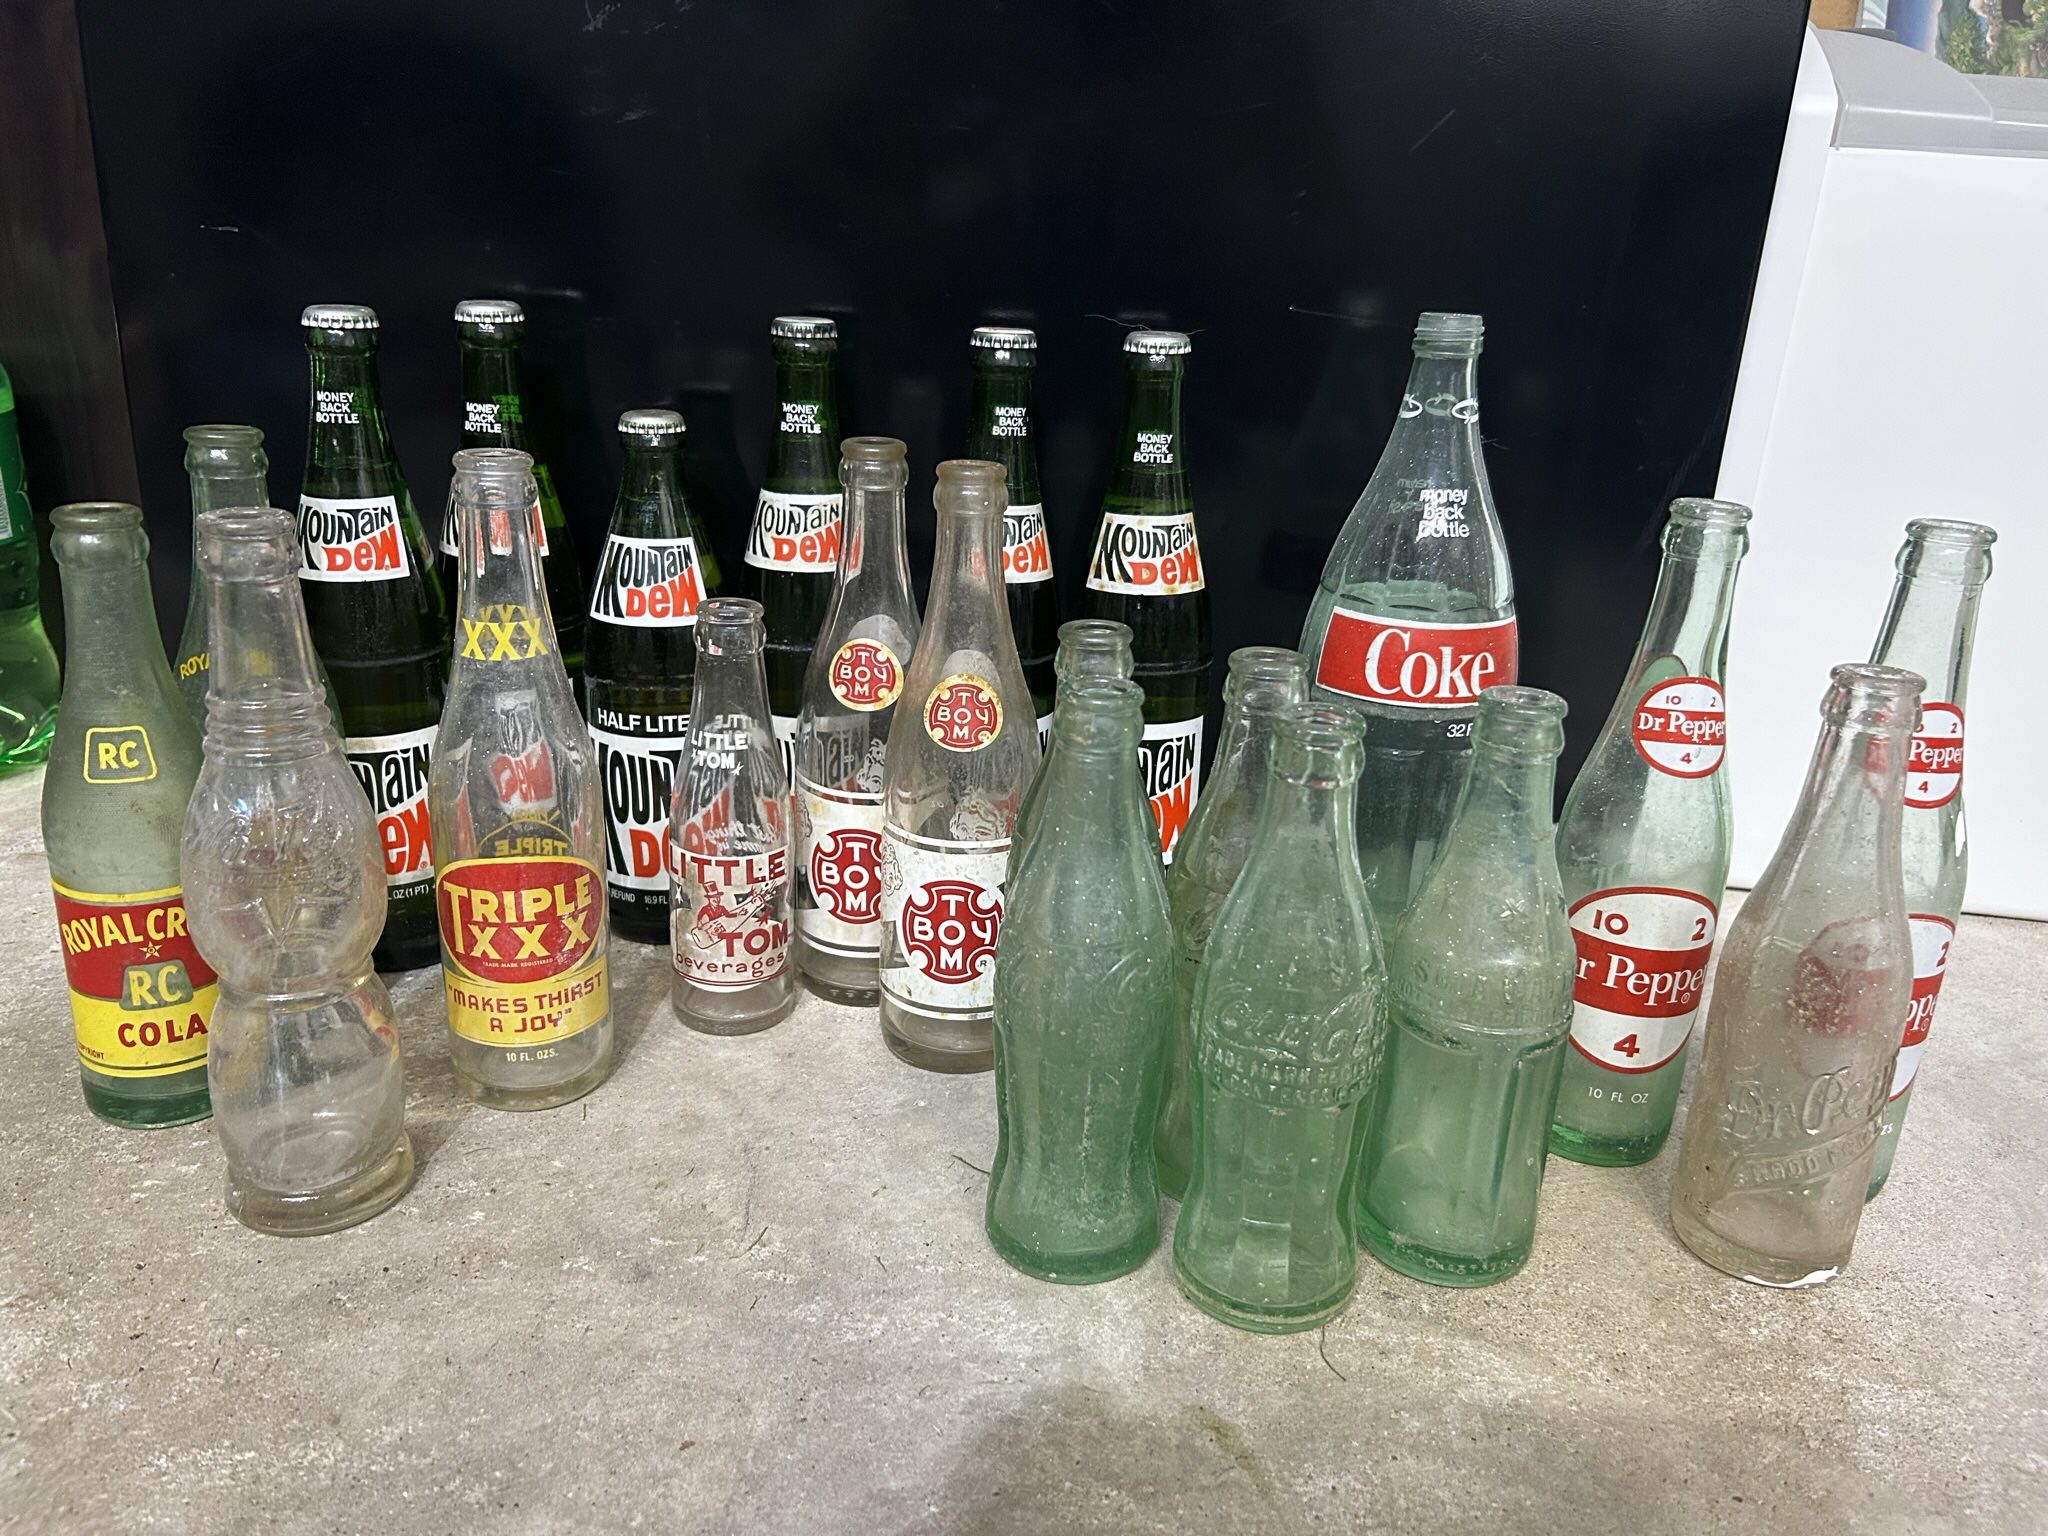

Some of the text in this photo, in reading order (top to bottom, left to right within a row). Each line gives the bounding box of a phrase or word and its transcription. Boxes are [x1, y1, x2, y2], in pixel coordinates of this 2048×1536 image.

[317, 391, 354, 403] MONEY
[320, 403, 351, 413] BACK
[466, 402, 500, 414] MONEY
[782, 402, 819, 415] MONEY
[995, 407, 1027, 417] MONEY
[315, 412, 359, 424] BOTTLE
[468, 412, 496, 423] BACK
[786, 413, 815, 424] BACK
[999, 417, 1024, 427] BACK
[464, 421, 502, 433] BOTTLE
[780, 421, 821, 434] BOTTLE
[992, 425, 1027, 436] BOTTLE
[1137, 433, 1173, 444] MONEY
[1140, 443, 1169, 454] BACK
[1133, 452, 1173, 464] BOTTLE
[1419, 489, 1468, 505] money
[1422, 503, 1464, 520] back
[460, 618, 548, 661] XXX
[1365, 628, 1495, 698] Coke
[1665, 695, 1717, 707] 10 2
[598, 708, 691, 732] HALF LITE
[1637, 712, 1665, 731] Dr
[1446, 724, 1465, 737] 32
[1950, 723, 1958, 733] 2
[691, 728, 749, 750] LITTLE
[98, 740, 139, 769] RC
[698, 749, 735, 769] TOM
[1679, 752, 1692, 764] 4
[1908, 740, 1963, 769] Peppe
[1918, 781, 1929, 793] 4
[670, 850, 785, 886] LITTLE
[393, 889, 405, 899] OZ
[611, 889, 636, 903] REFUND
[443, 874, 593, 954] TRIPLE
[61, 907, 187, 955] ROYAL CR
[1593, 909, 1707, 941] 10 2
[718, 918, 788, 957] TOM
[1936, 941, 1950, 967] 2
[676, 951, 785, 978] beverages
[1576, 957, 1596, 979] r
[128, 965, 182, 1006] RC
[534, 970, 602, 1010] THIRST
[118, 1012, 208, 1048] COLA
[490, 1017, 504, 1032] A
[1613, 1034, 1640, 1058] 4
[506, 1052, 518, 1062] 10
[1588, 1087, 1649, 1104] 10 FL OZ
[1880, 1122, 1894, 1136] ZS
